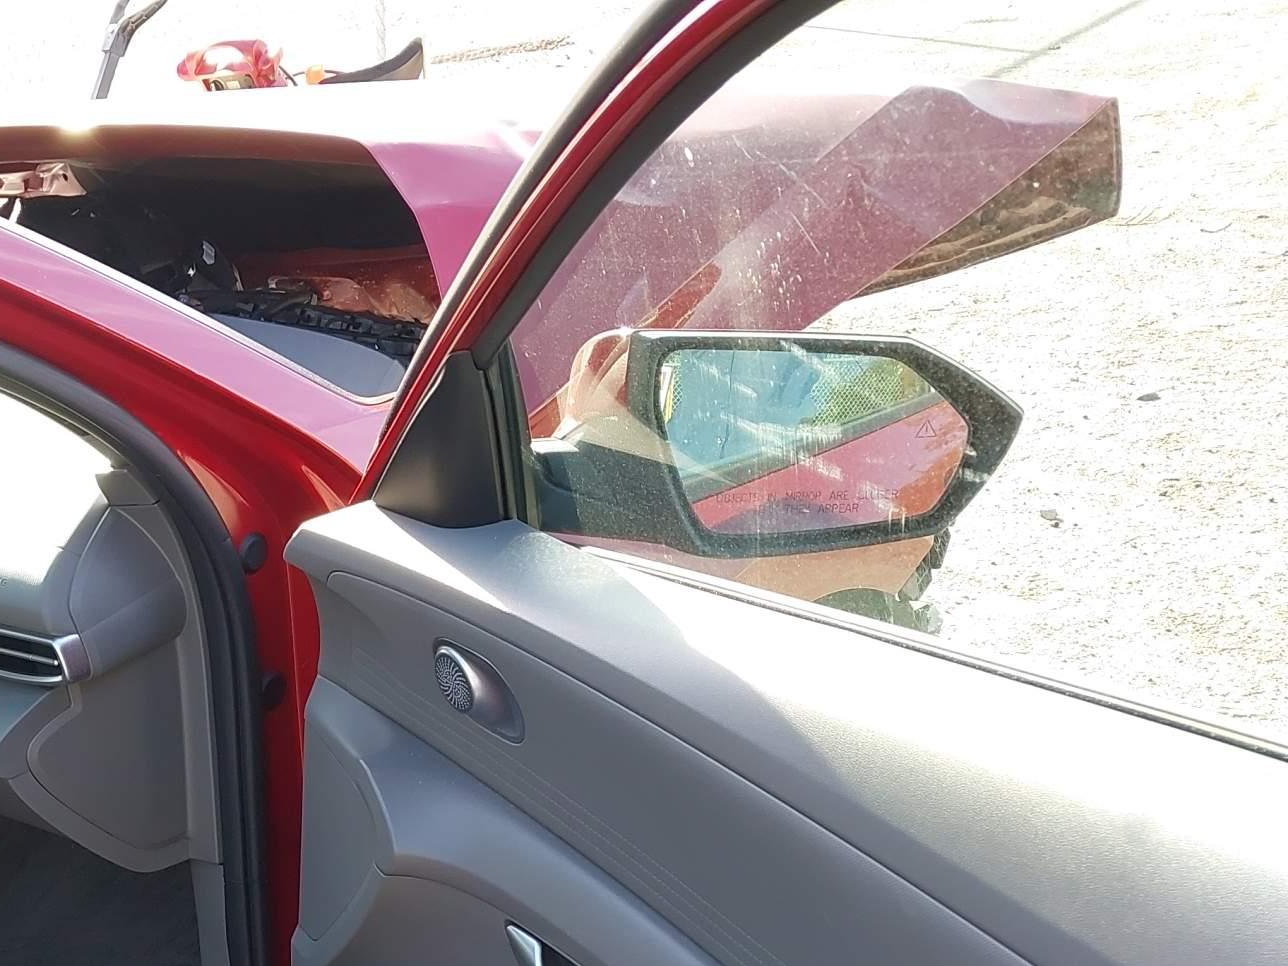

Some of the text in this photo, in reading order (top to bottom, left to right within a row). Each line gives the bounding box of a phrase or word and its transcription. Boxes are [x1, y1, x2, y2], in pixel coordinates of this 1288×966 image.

[767, 491, 777, 502] IN
[829, 489, 849, 501] ARE
[784, 503, 810, 514] THEY
[818, 502, 860, 514] APPEAR
